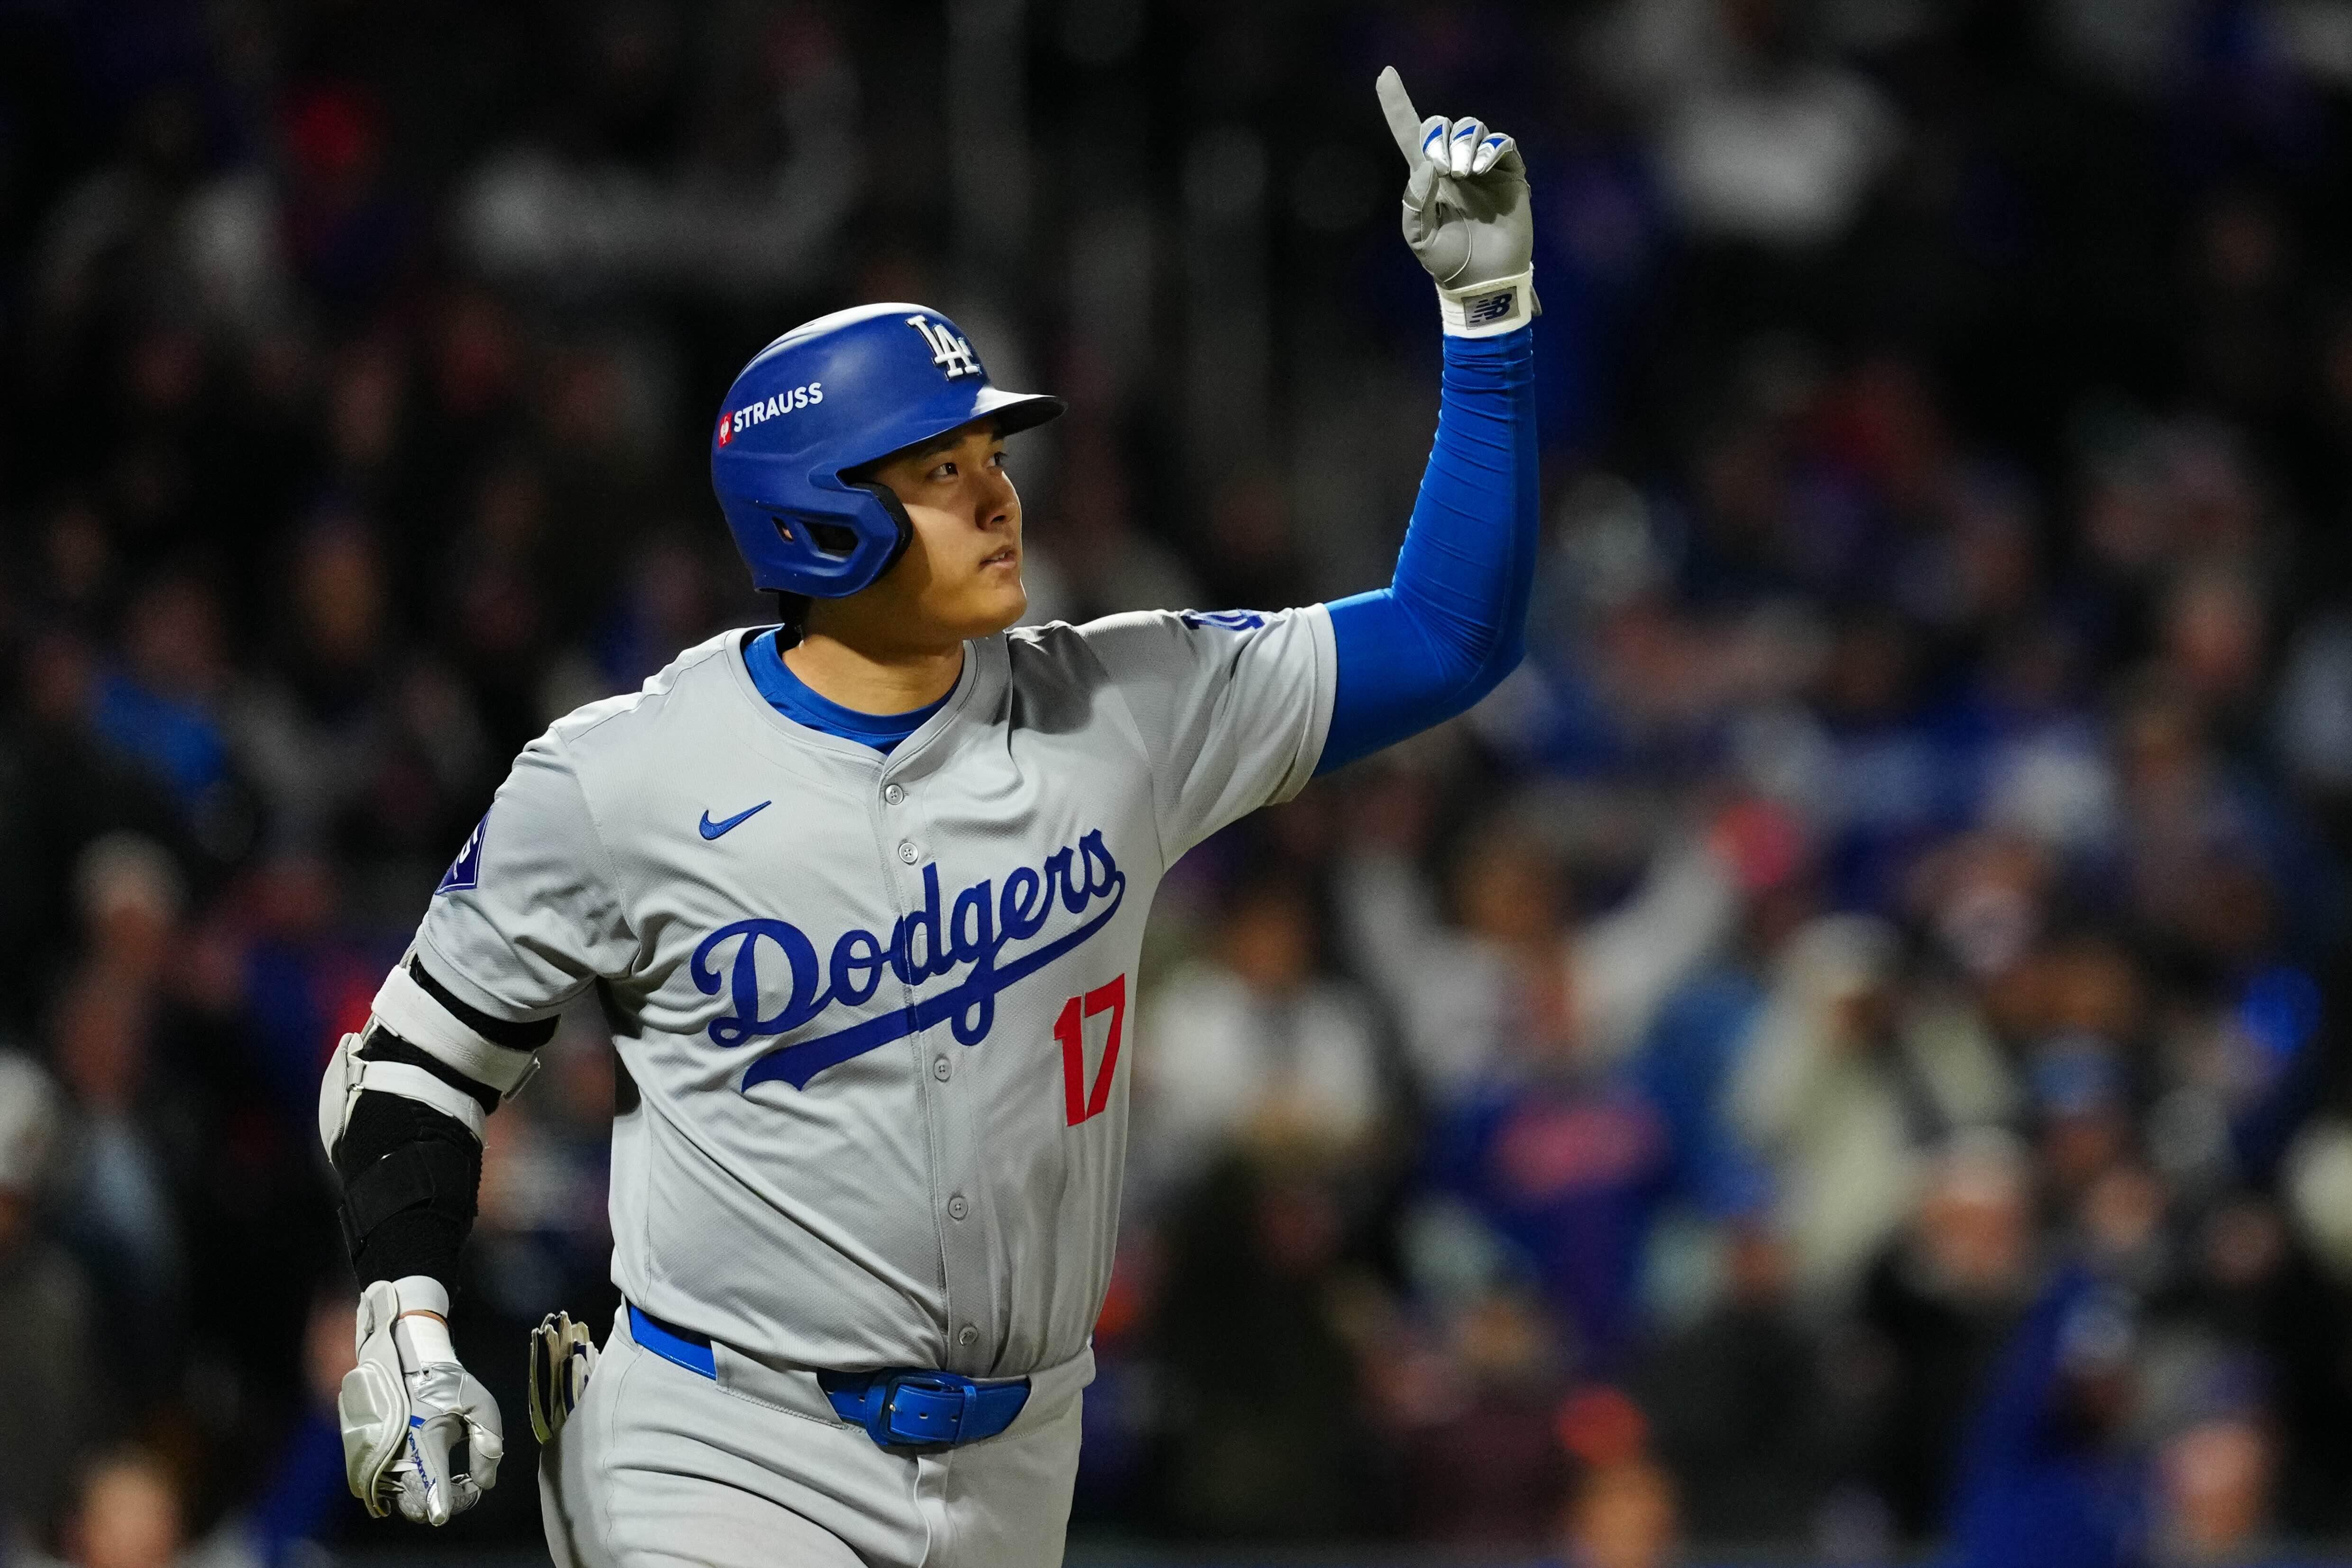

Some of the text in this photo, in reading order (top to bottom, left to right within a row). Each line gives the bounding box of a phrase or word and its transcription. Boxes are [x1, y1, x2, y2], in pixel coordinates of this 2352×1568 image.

[905, 314, 981, 378] LA
[734, 382, 823, 432] STRAUSS
[690, 828, 1126, 1048] Dodgers
[1053, 972, 1125, 1127] 17
